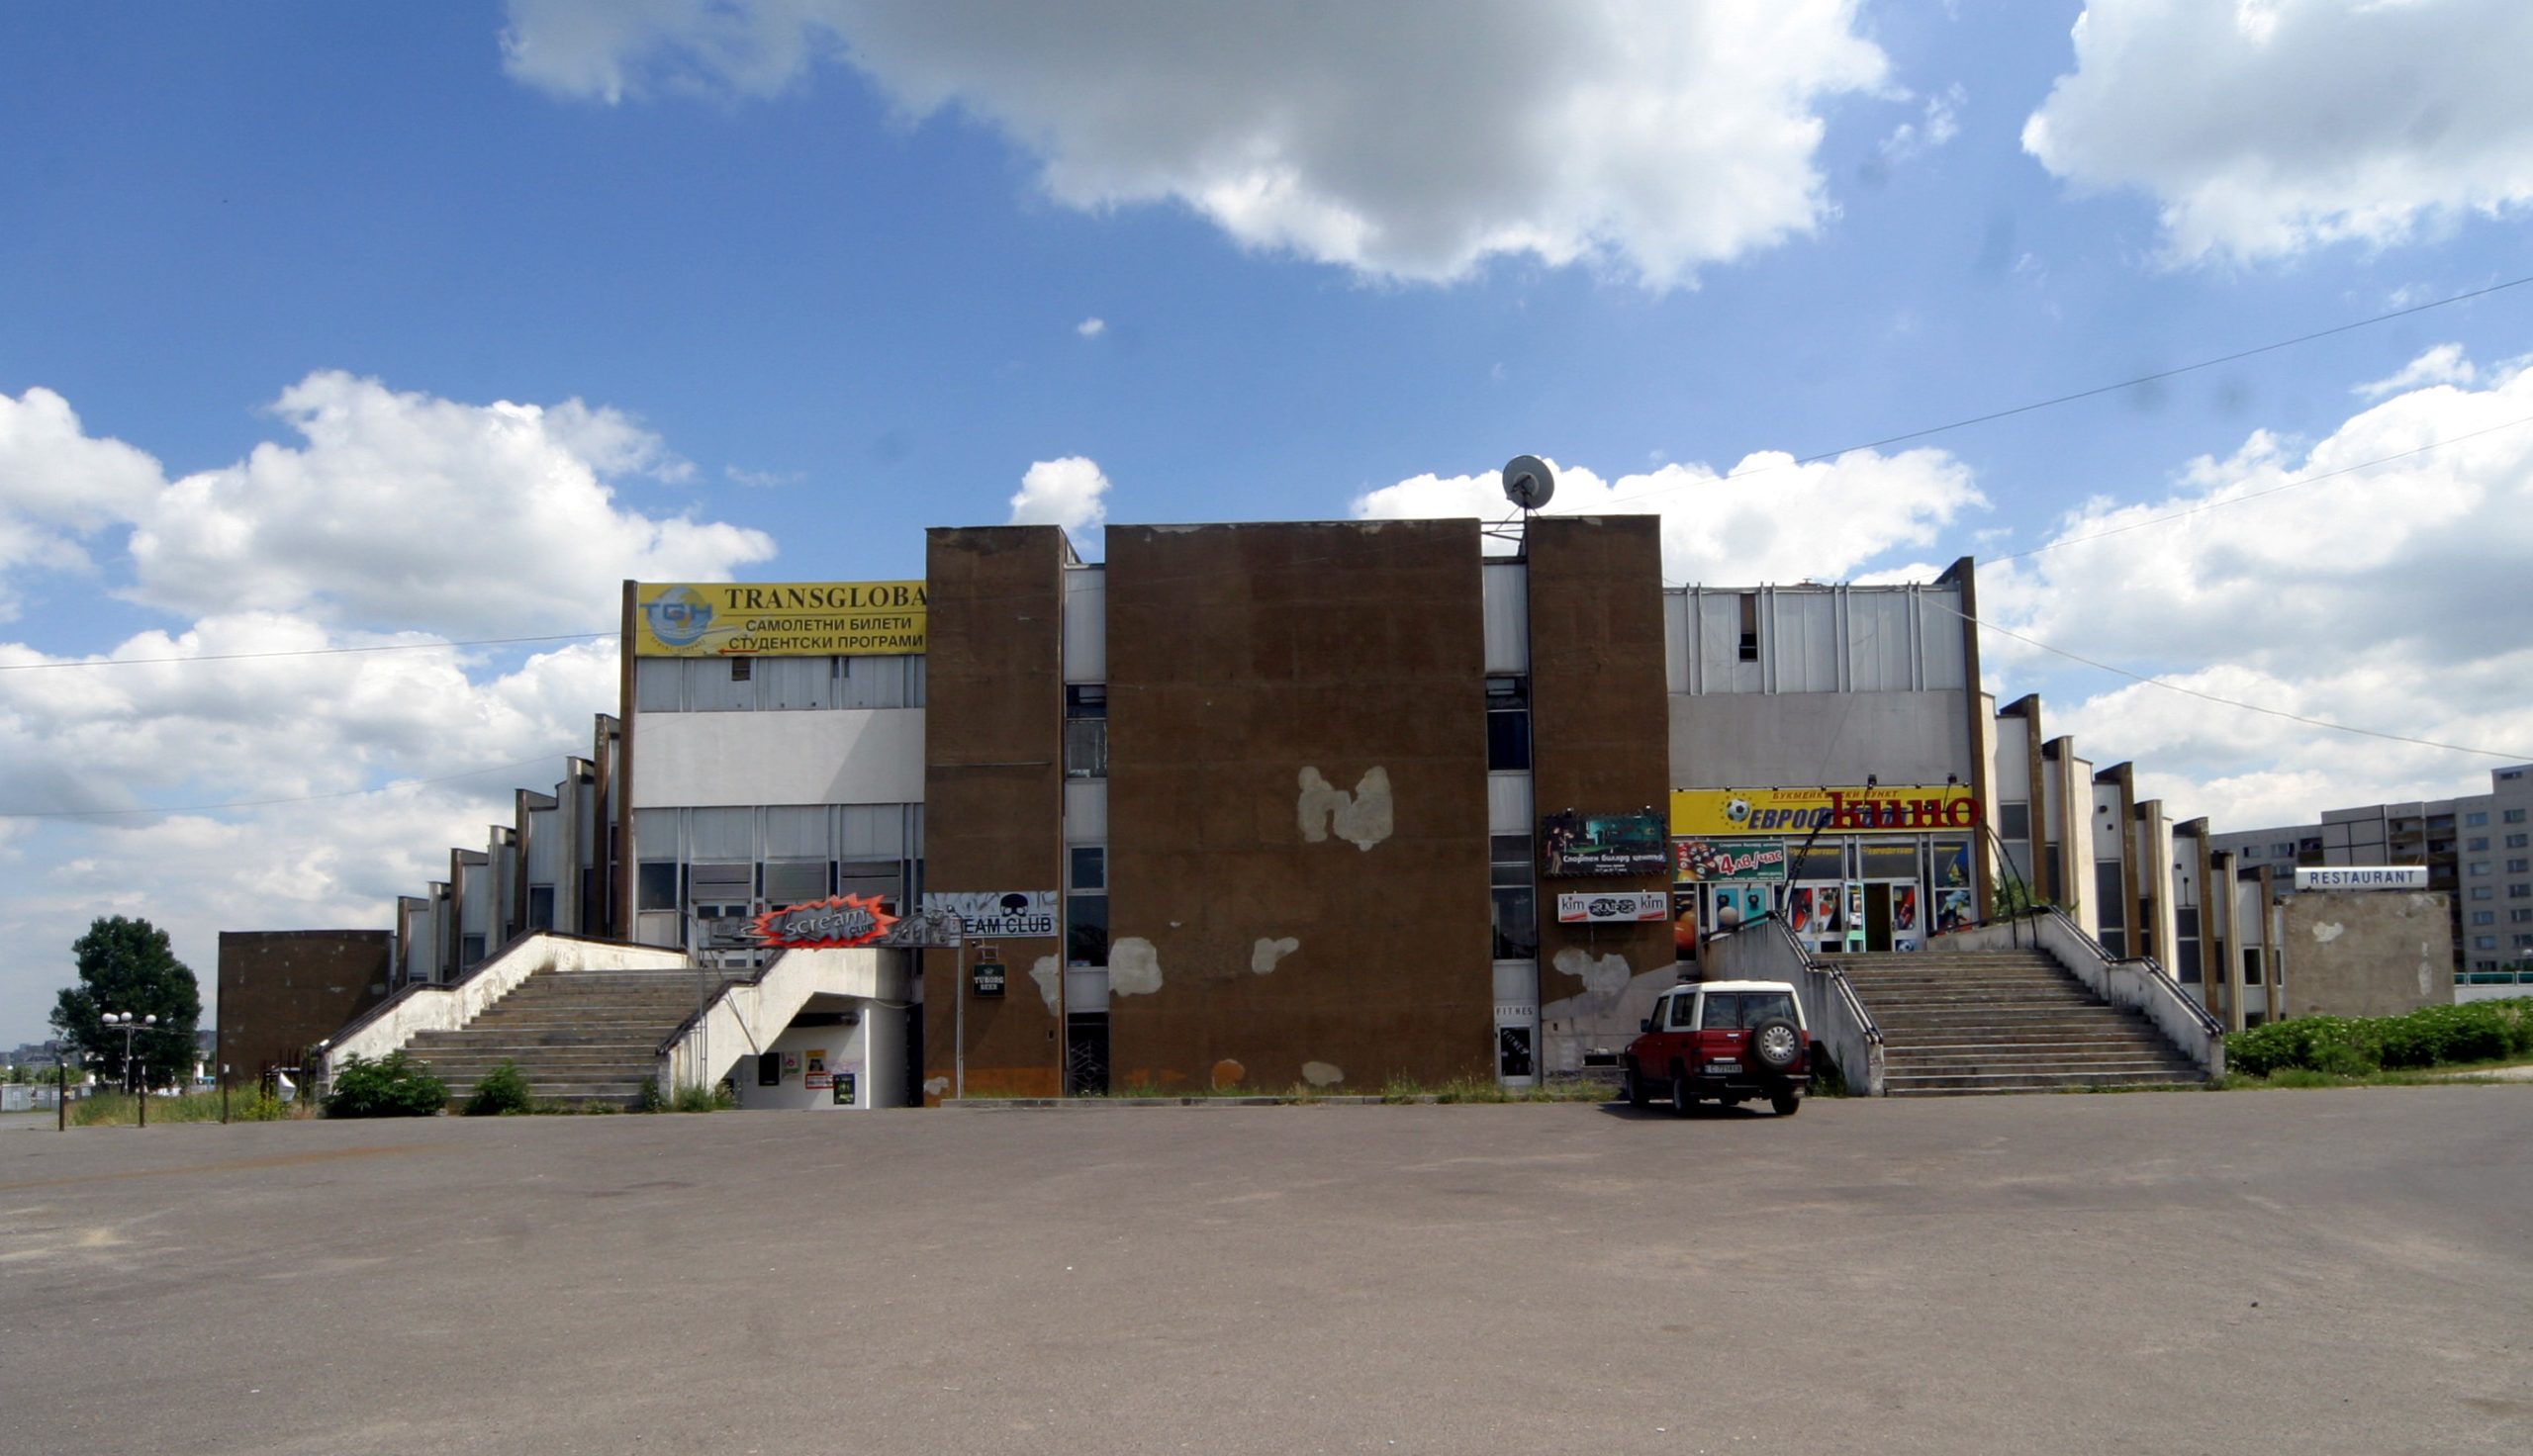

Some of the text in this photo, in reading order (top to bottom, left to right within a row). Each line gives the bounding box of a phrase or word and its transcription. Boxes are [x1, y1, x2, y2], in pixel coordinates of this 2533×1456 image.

[745, 617, 912, 632] САМОЛЕТНИ БИЛЕТИ
[729, 635, 923, 650] СТУДЕНТСКИ ПРОГРАМИ
[2310, 870, 2415, 884] RESTAURANT
[1562, 896, 1584, 910] kim
[1641, 894, 1663, 908] kim
[786, 909, 867, 936] scream
[1006, 917, 1052, 933] CLUB
[974, 975, 1004, 984] TUBORG
[1496, 1007, 1533, 1016] FITNES
